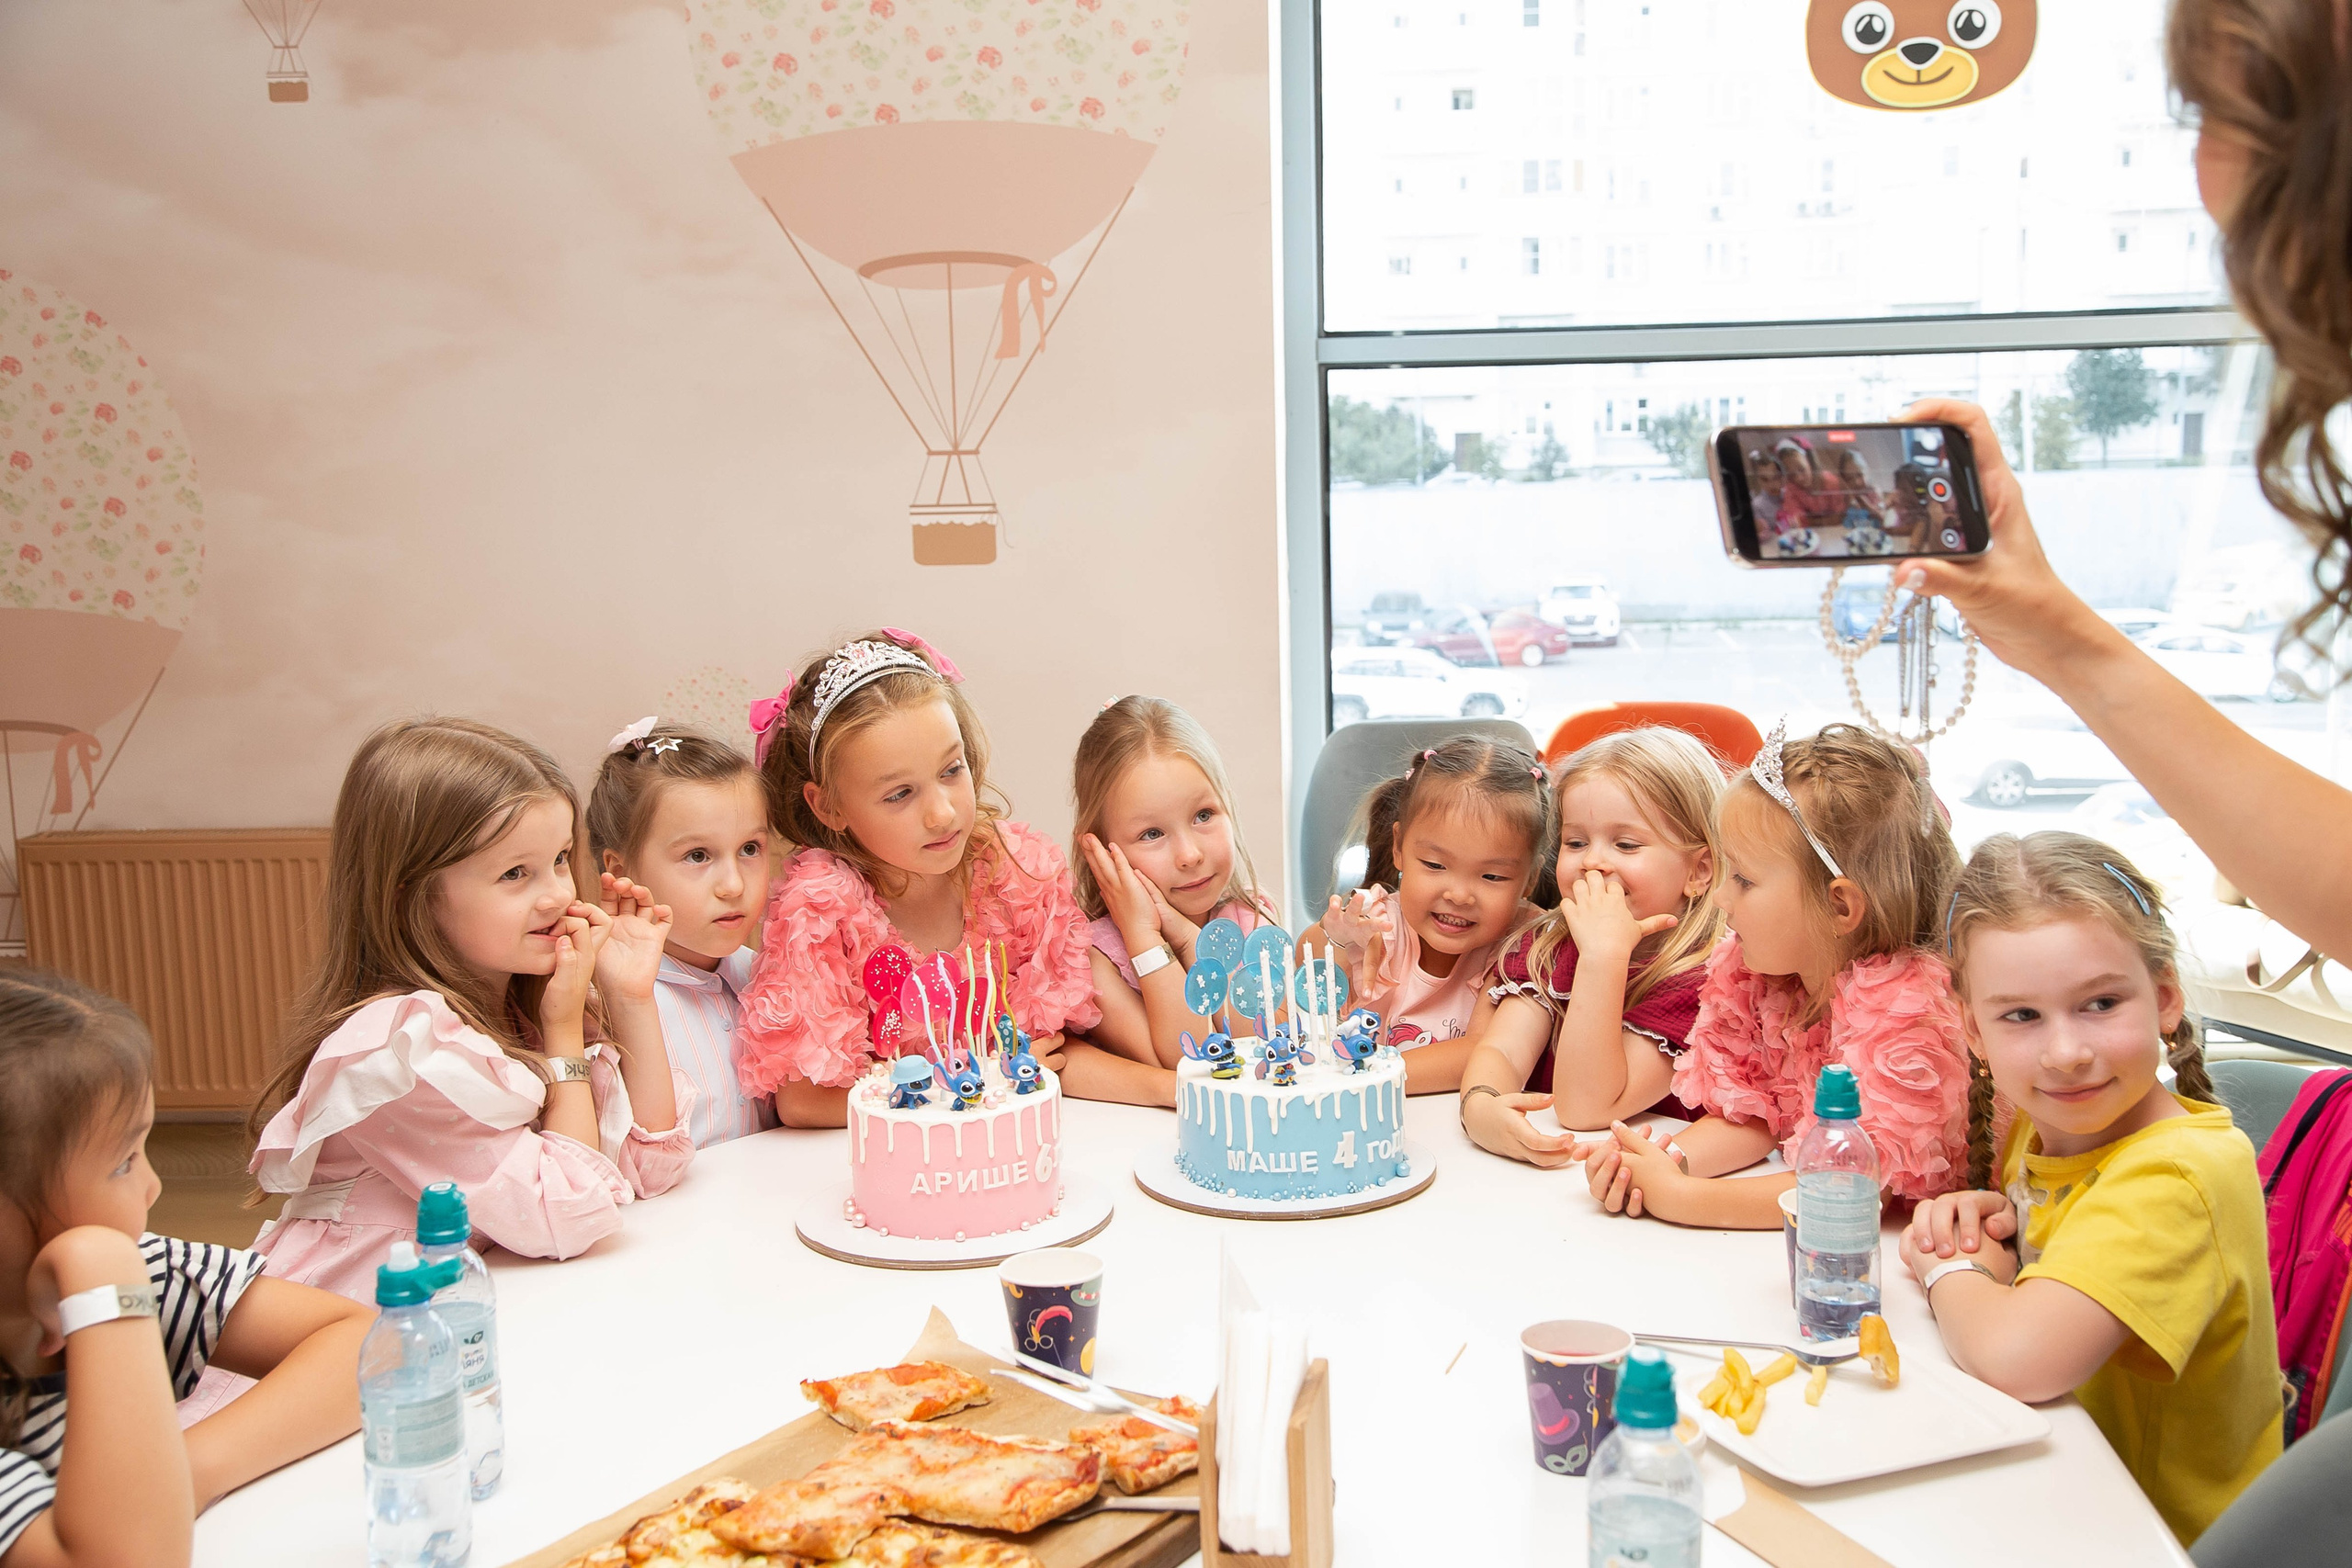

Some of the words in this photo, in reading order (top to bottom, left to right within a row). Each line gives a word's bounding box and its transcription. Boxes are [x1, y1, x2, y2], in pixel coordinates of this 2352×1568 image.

[910, 1160, 1029, 1195] АРИШЕ
[1035, 1143, 1053, 1183] 6
[1227, 1149, 1319, 1173] МАШЕ
[1332, 1130, 1359, 1168] 4
[1365, 1125, 1404, 1163] ГОД
